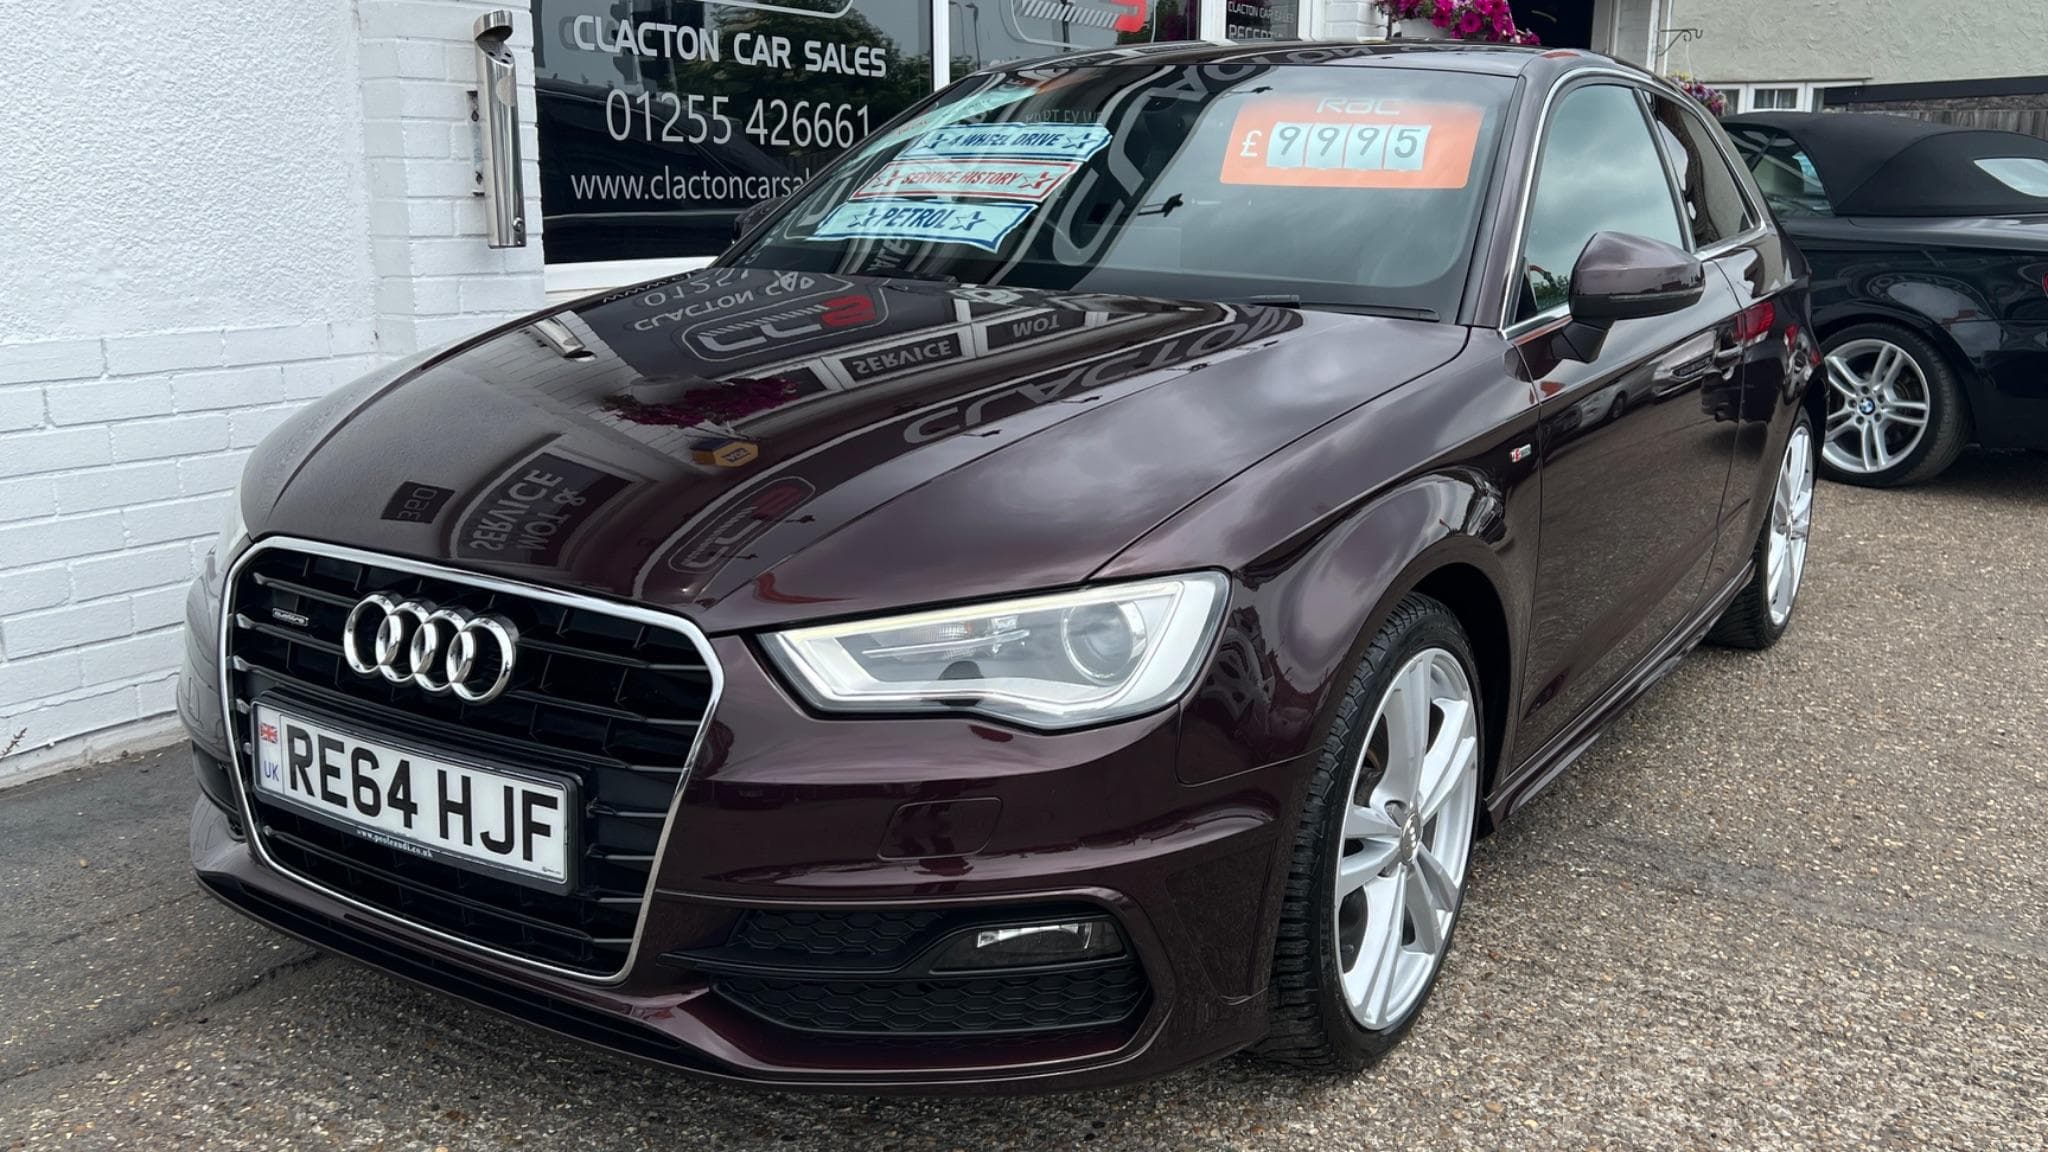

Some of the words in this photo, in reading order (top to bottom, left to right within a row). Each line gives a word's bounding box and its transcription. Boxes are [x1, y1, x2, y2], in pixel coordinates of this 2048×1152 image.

[573, 15, 719, 63] CLACTON
[734, 32, 791, 69] CAR
[804, 41, 886, 77] SALES
[606, 89, 732, 144] 01255
[745, 99, 869, 148] 426661
[1010, 133, 1065, 146] DRIVE
[1279, 126, 1421, 159] 9995
[902, 171, 960, 184] SERVICE
[960, 171, 1023, 185] HISTORY
[879, 207, 956, 228] PETROL
[264, 760, 280, 782] UK
[285, 723, 418, 829] RE64
[437, 768, 558, 863] HJF
